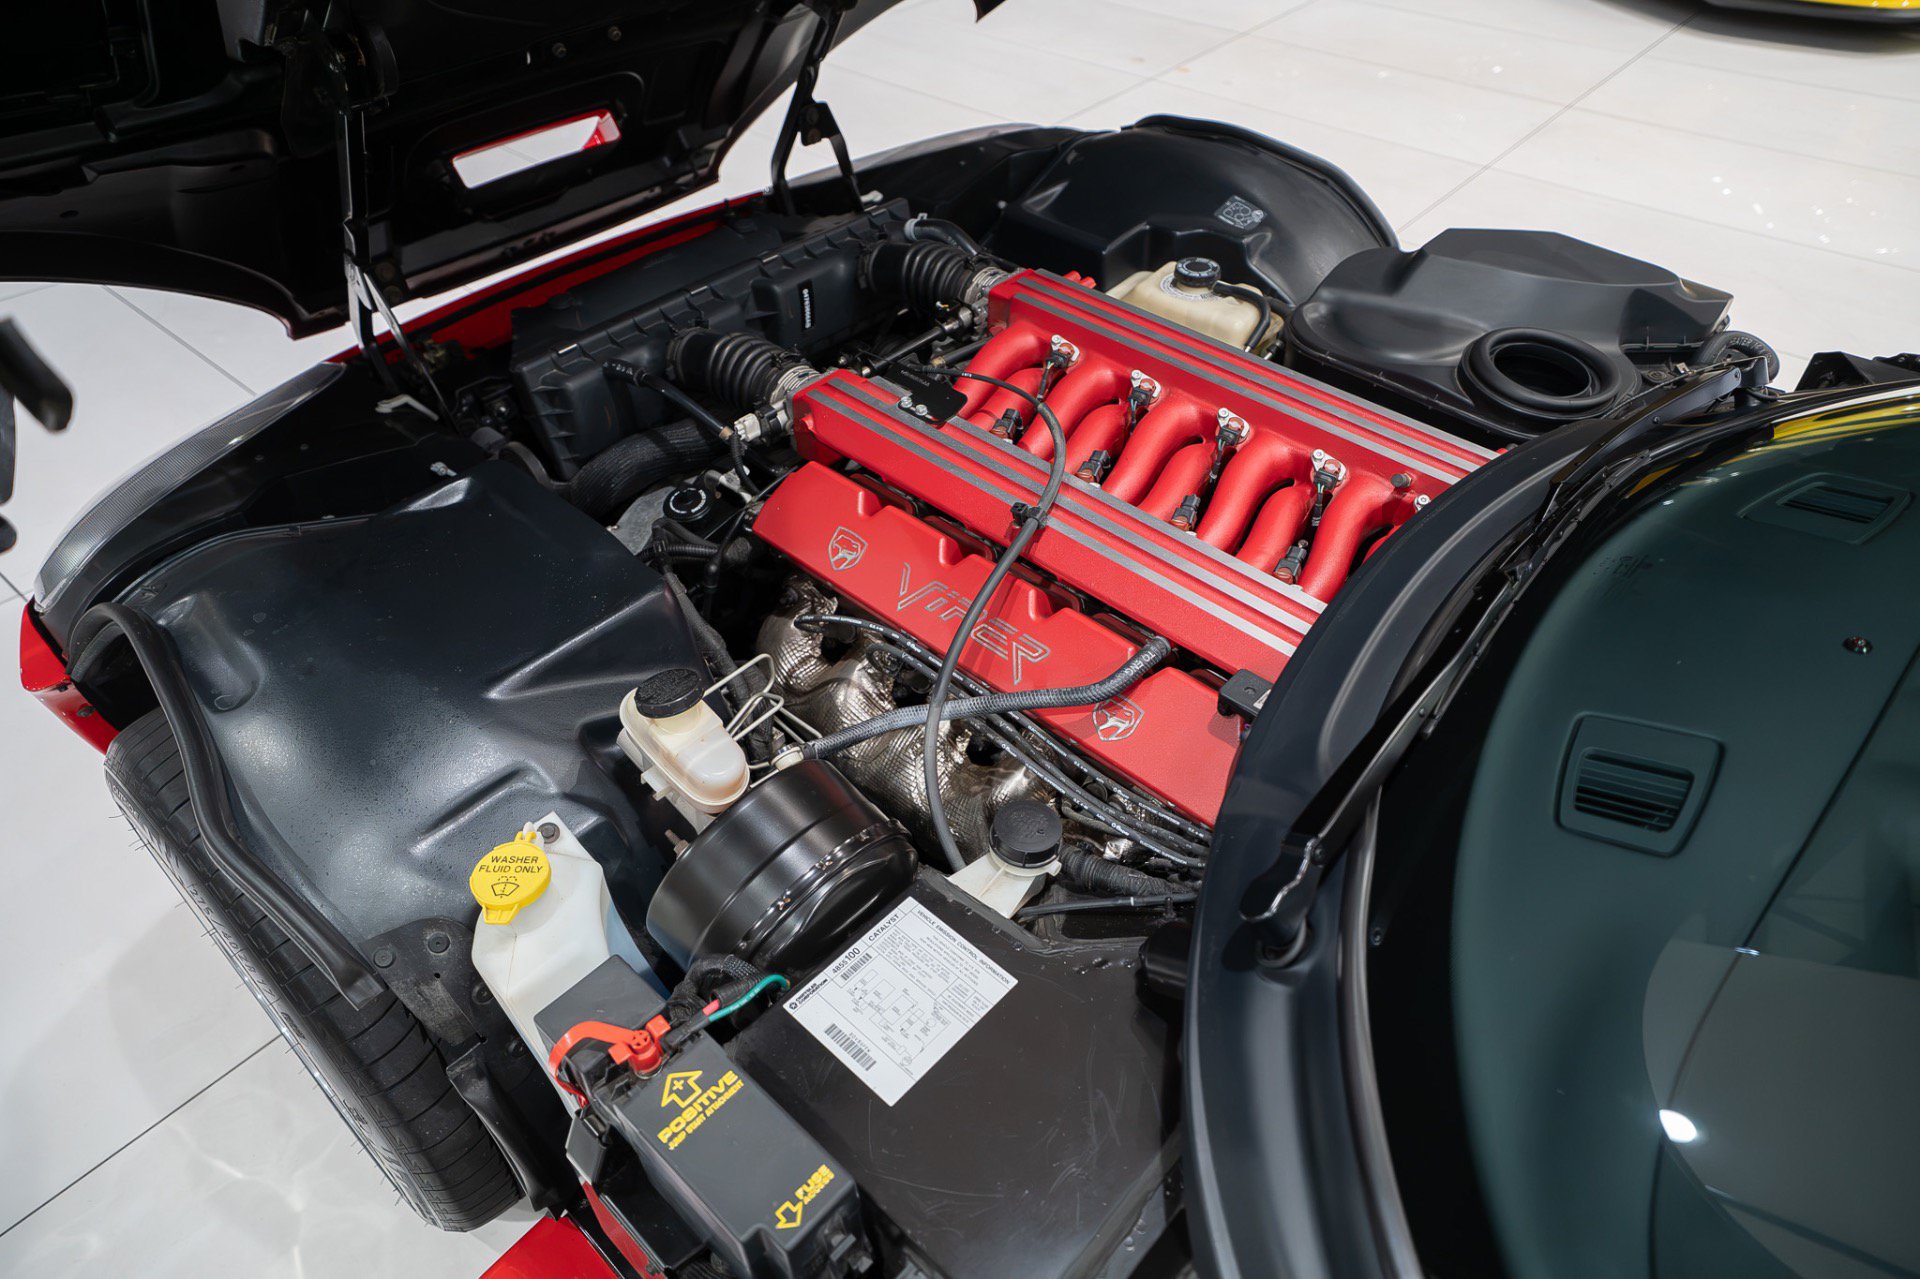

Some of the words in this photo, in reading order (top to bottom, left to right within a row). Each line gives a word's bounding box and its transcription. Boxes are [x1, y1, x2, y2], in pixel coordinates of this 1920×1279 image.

[478, 864, 511, 873] FLUID
[514, 865, 543, 873] ONLY
[491, 855, 539, 864] WASHER
[868, 913, 900, 942] CATALYST
[831, 947, 861, 975] 4855100
[916, 909, 937, 928] VEHICLE
[936, 924, 957, 944] EMISSION
[956, 940, 980, 961] CONTROL
[978, 957, 1012, 985] INFORMATION
[657, 1070, 739, 1144] POSITIVE
[794, 1164, 831, 1200] FUSE
